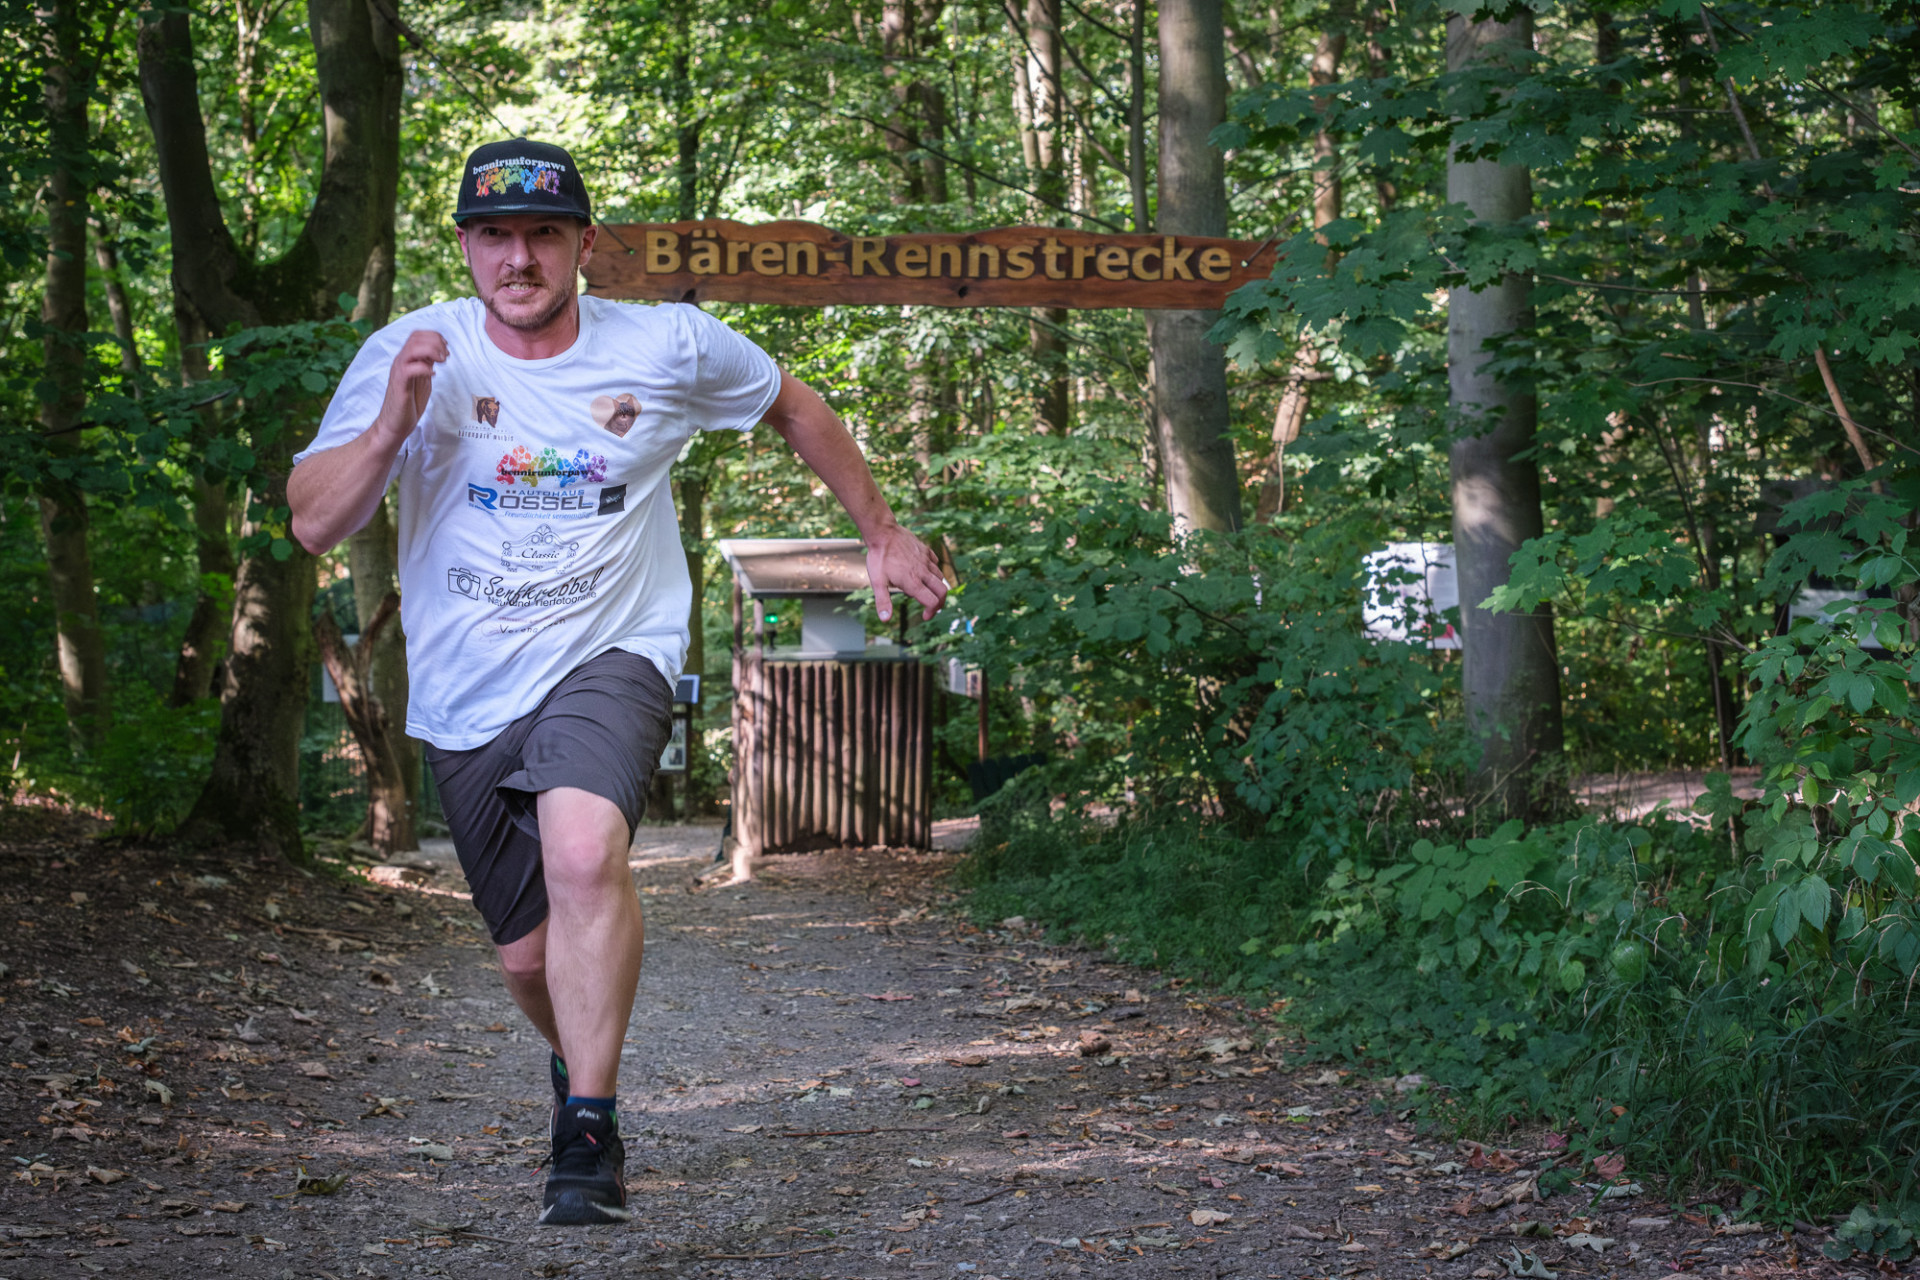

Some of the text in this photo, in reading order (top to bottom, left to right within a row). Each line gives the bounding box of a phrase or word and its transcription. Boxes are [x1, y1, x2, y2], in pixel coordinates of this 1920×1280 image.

[473, 156, 566, 175] bennirunforpaws
[645, 229, 1232, 282] Bären-Rennstrecke
[500, 468, 595, 478] bennirunforpaws
[518, 489, 585, 497] AUTOHAUS
[521, 547, 560, 559] Classic
